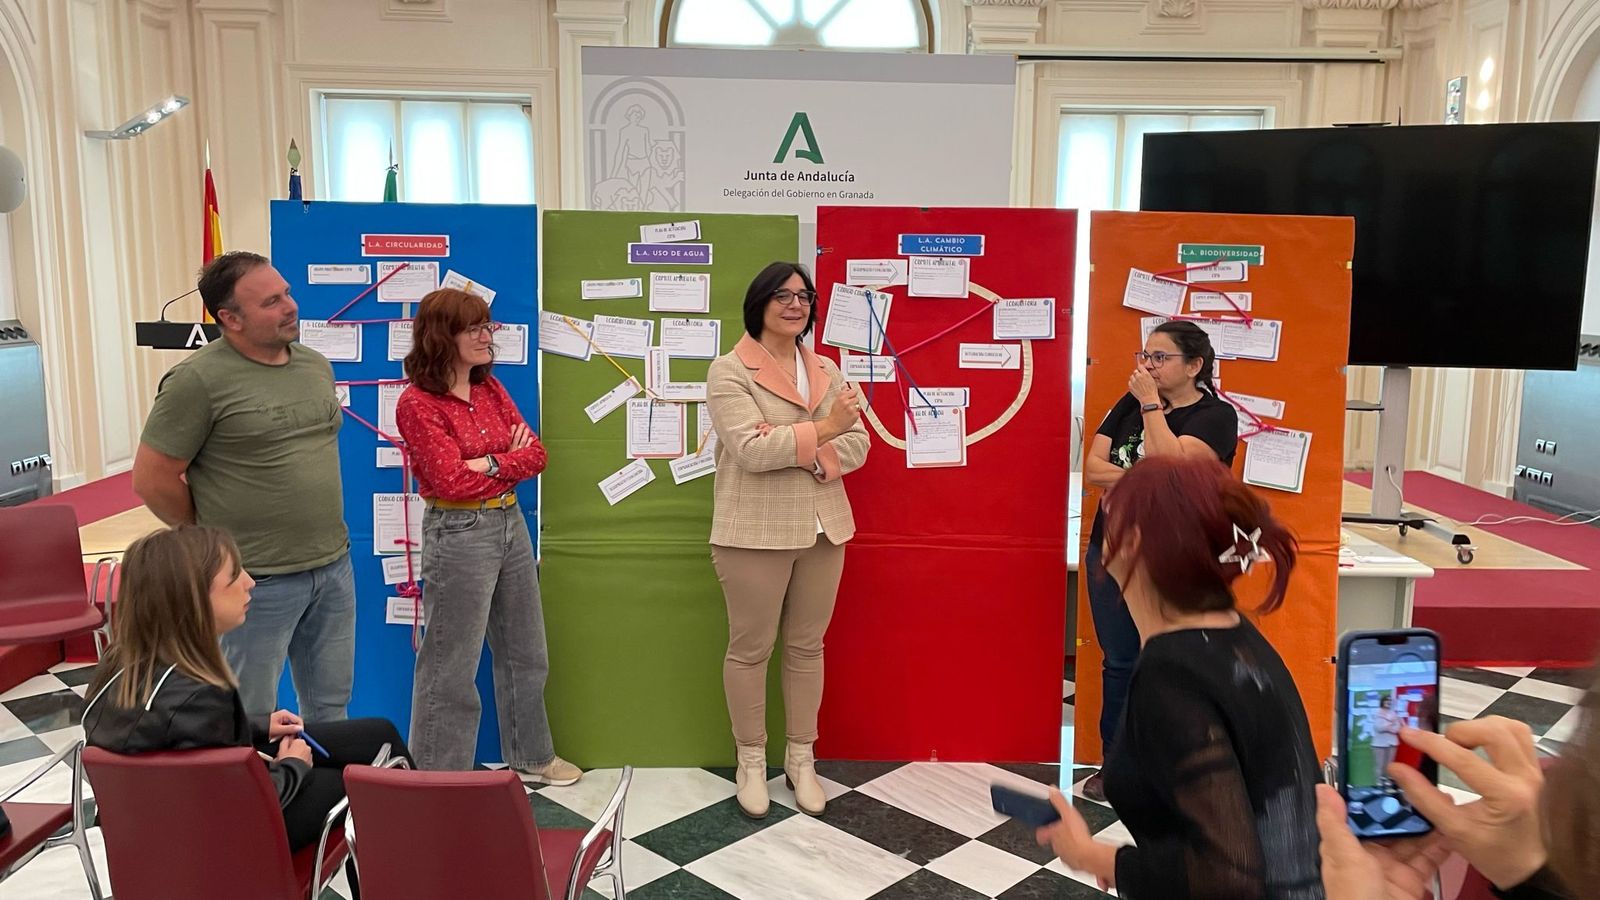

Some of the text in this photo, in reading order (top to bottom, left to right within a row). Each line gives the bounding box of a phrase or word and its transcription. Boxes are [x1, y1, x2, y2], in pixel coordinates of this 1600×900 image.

[743, 170, 855, 182] Junta de Andalucía
[723, 188, 770, 199] Delegación
[772, 188, 785, 198] del
[787, 189, 825, 199] Gobierno
[839, 190, 874, 200] Granada
[385, 241, 443, 249] CIRCULARIDAD
[935, 237, 966, 245] CAMBIO
[920, 245, 963, 253] CLIMÁTICO
[1199, 249, 1260, 258] BIODIVERSIDAD
